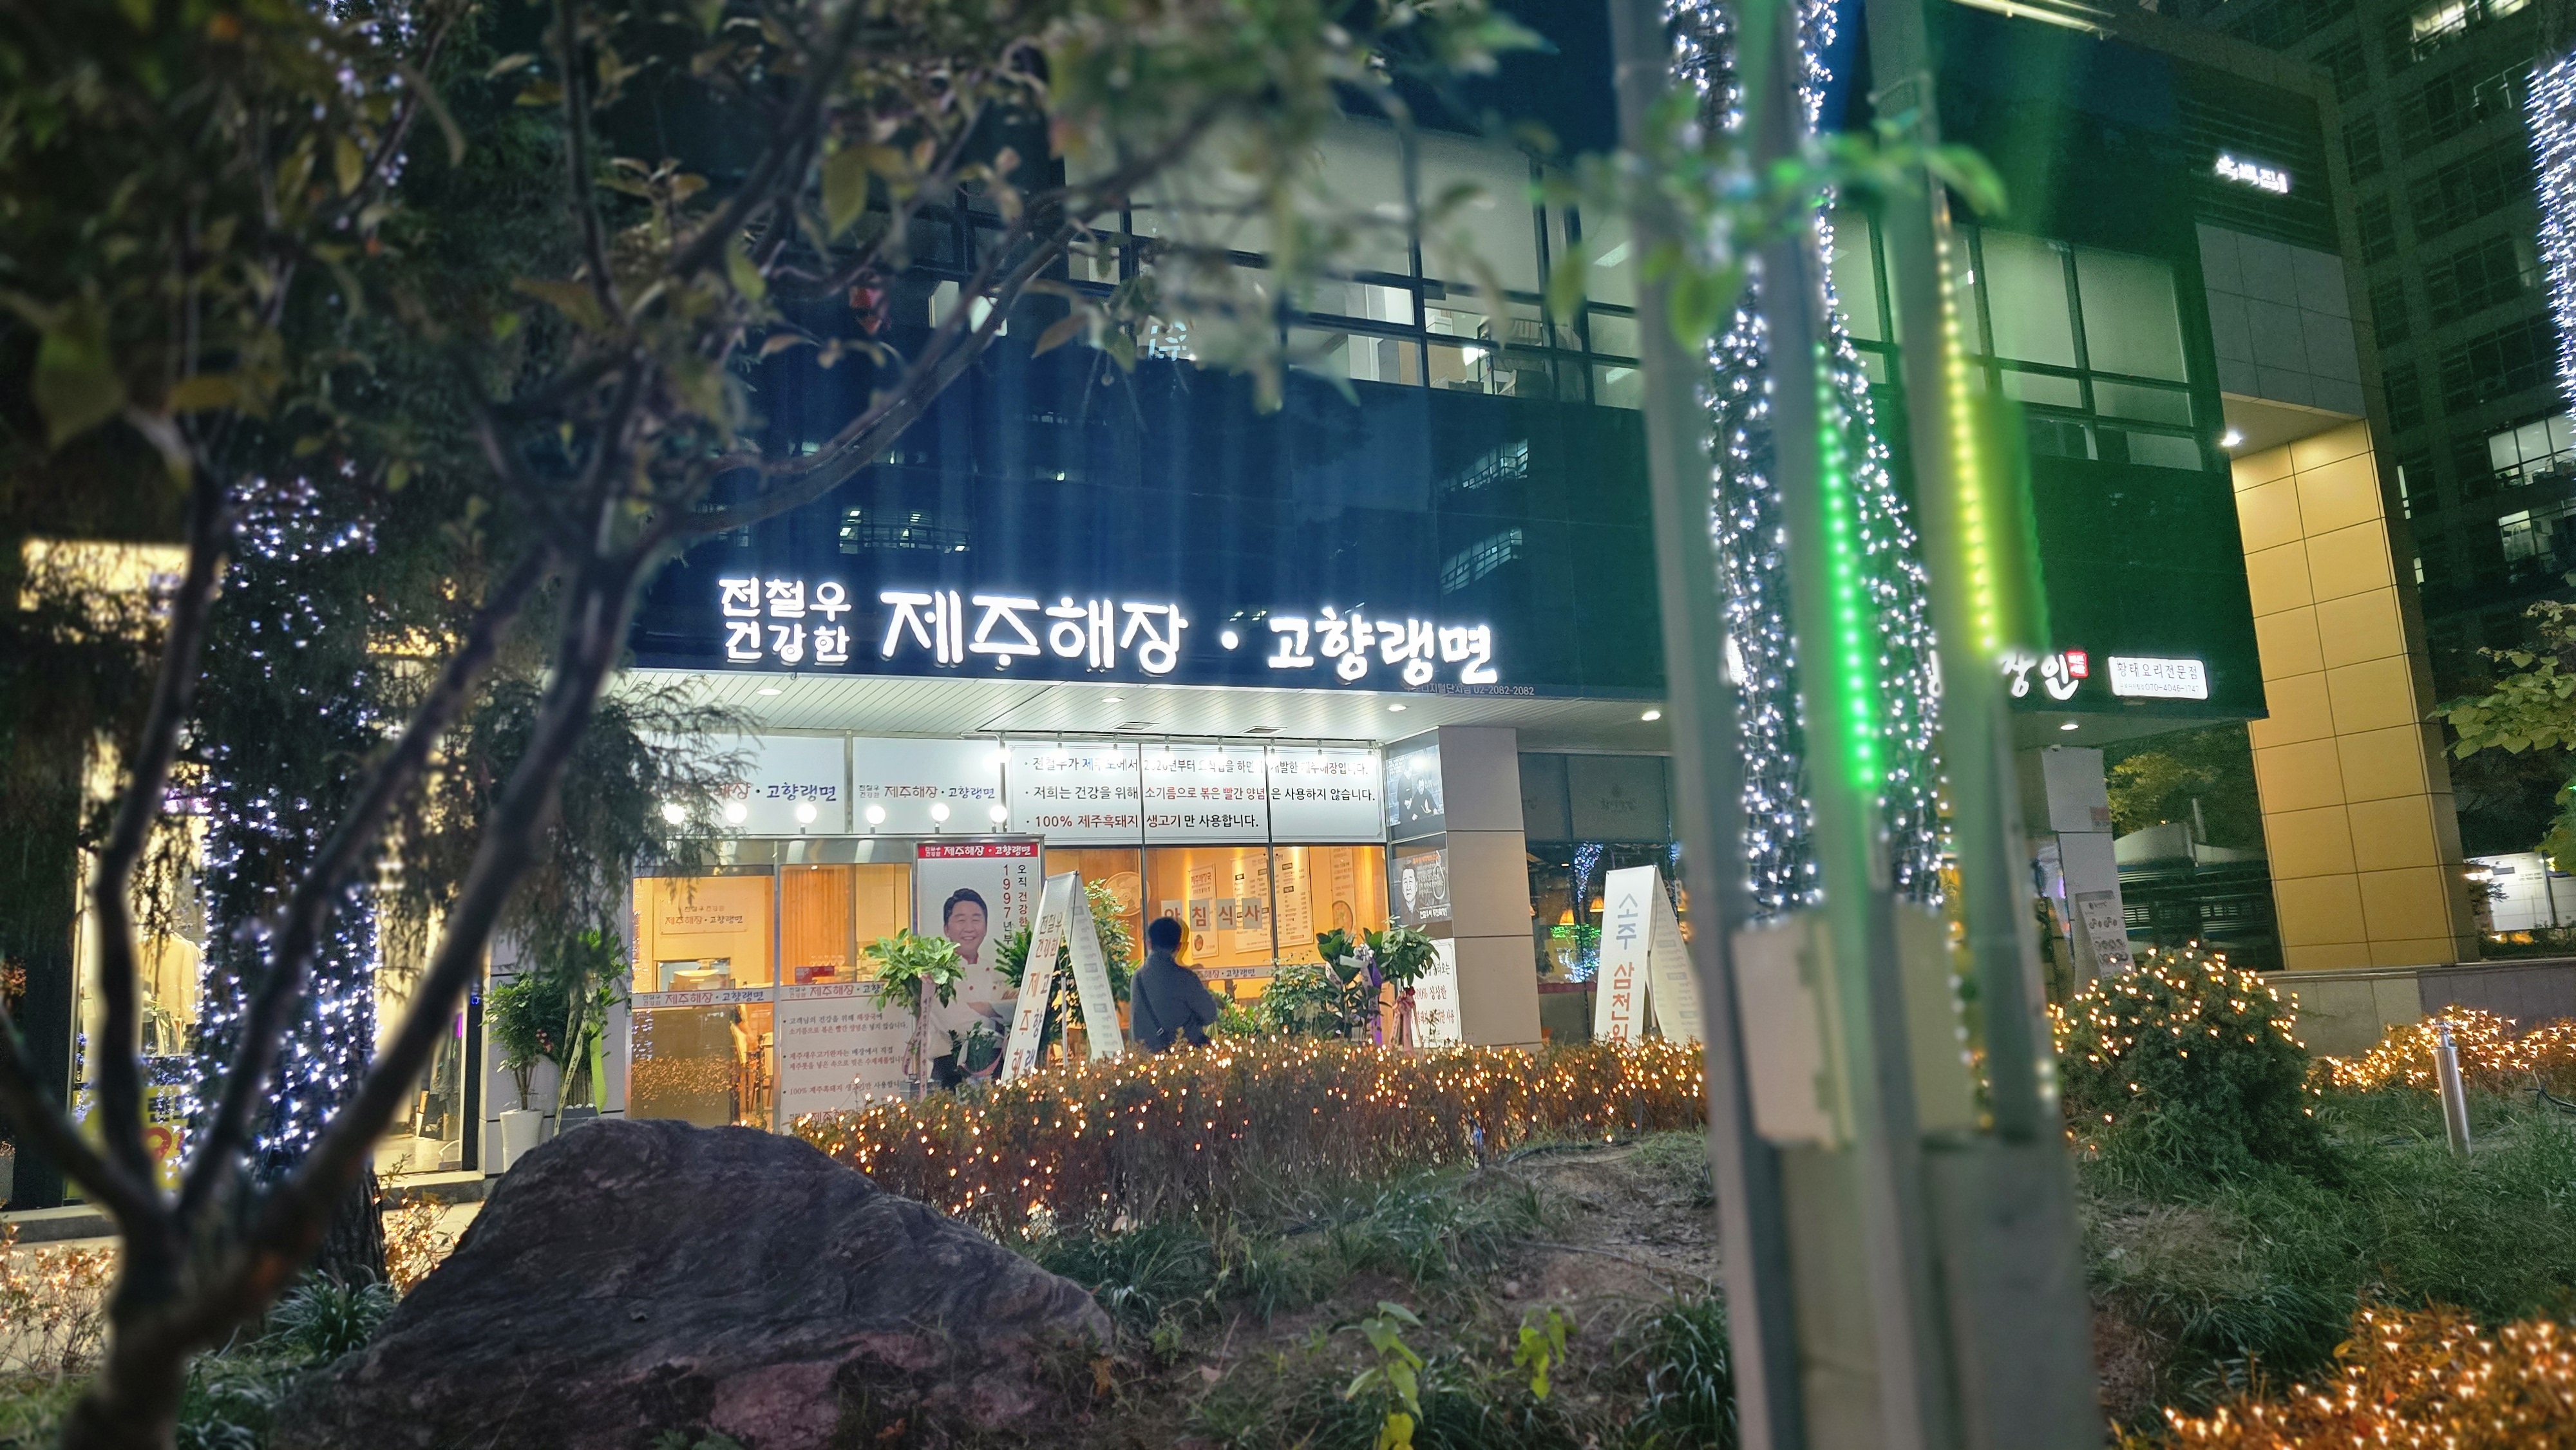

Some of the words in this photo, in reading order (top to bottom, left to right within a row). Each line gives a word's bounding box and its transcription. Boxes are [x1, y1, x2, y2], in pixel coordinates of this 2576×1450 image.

[718, 578, 852, 622] 전철우
[724, 621, 850, 663] 건강한
[879, 589, 1188, 674] 제주해장
[1267, 607, 1499, 686] 고향랭면
[2117, 661, 2197, 680] 황태요리전문점
[1474, 686, 1534, 695] 02-2082-2082
[766, 782, 837, 802] 고향랭면
[884, 786, 938, 798] 제주해장
[948, 786, 995, 800] 고향랭면
[1034, 787, 1072, 800] 저희는
[1075, 786, 1111, 800] 건강을
[1115, 787, 1139, 800] 위해
[1145, 787, 1197, 800] 소기름으로
[1200, 787, 1220, 800] 볶은
[1223, 787, 1243, 800] 빨간
[1285, 788, 1327, 800] 사용하지
[1331, 788, 1376, 801] 않습니다.
[1036, 815, 1072, 827] 100%
[1077, 814, 1138, 828] 제주흑돼지
[1198, 814, 1259, 828] 사용합니다.
[943, 845, 985, 856] 제주해장
[995, 845, 1032, 856] 고향랭면
[1017, 864, 1027, 887] 오직
[1003, 864, 1013, 945] 1997년부
[1018, 891, 1028, 927] 건강한
[665, 916, 703, 925] 제주해장
[710, 916, 743, 924] 고향랭면
[1039, 911, 1062, 935] 전철우
[1616, 893, 1638, 951] 소주
[1035, 937, 1059, 958] 건강한
[1198, 970, 1219, 978] 주해장
[665, 993, 714, 1004] 제주해장
[722, 991, 764, 1002] 고향랭면
[810, 984, 854, 997] 제주해장
[862, 983, 882, 993] 고향
[789, 1027, 819, 1035] 소기름으로
[874, 1080, 900, 1089] 사용합니
